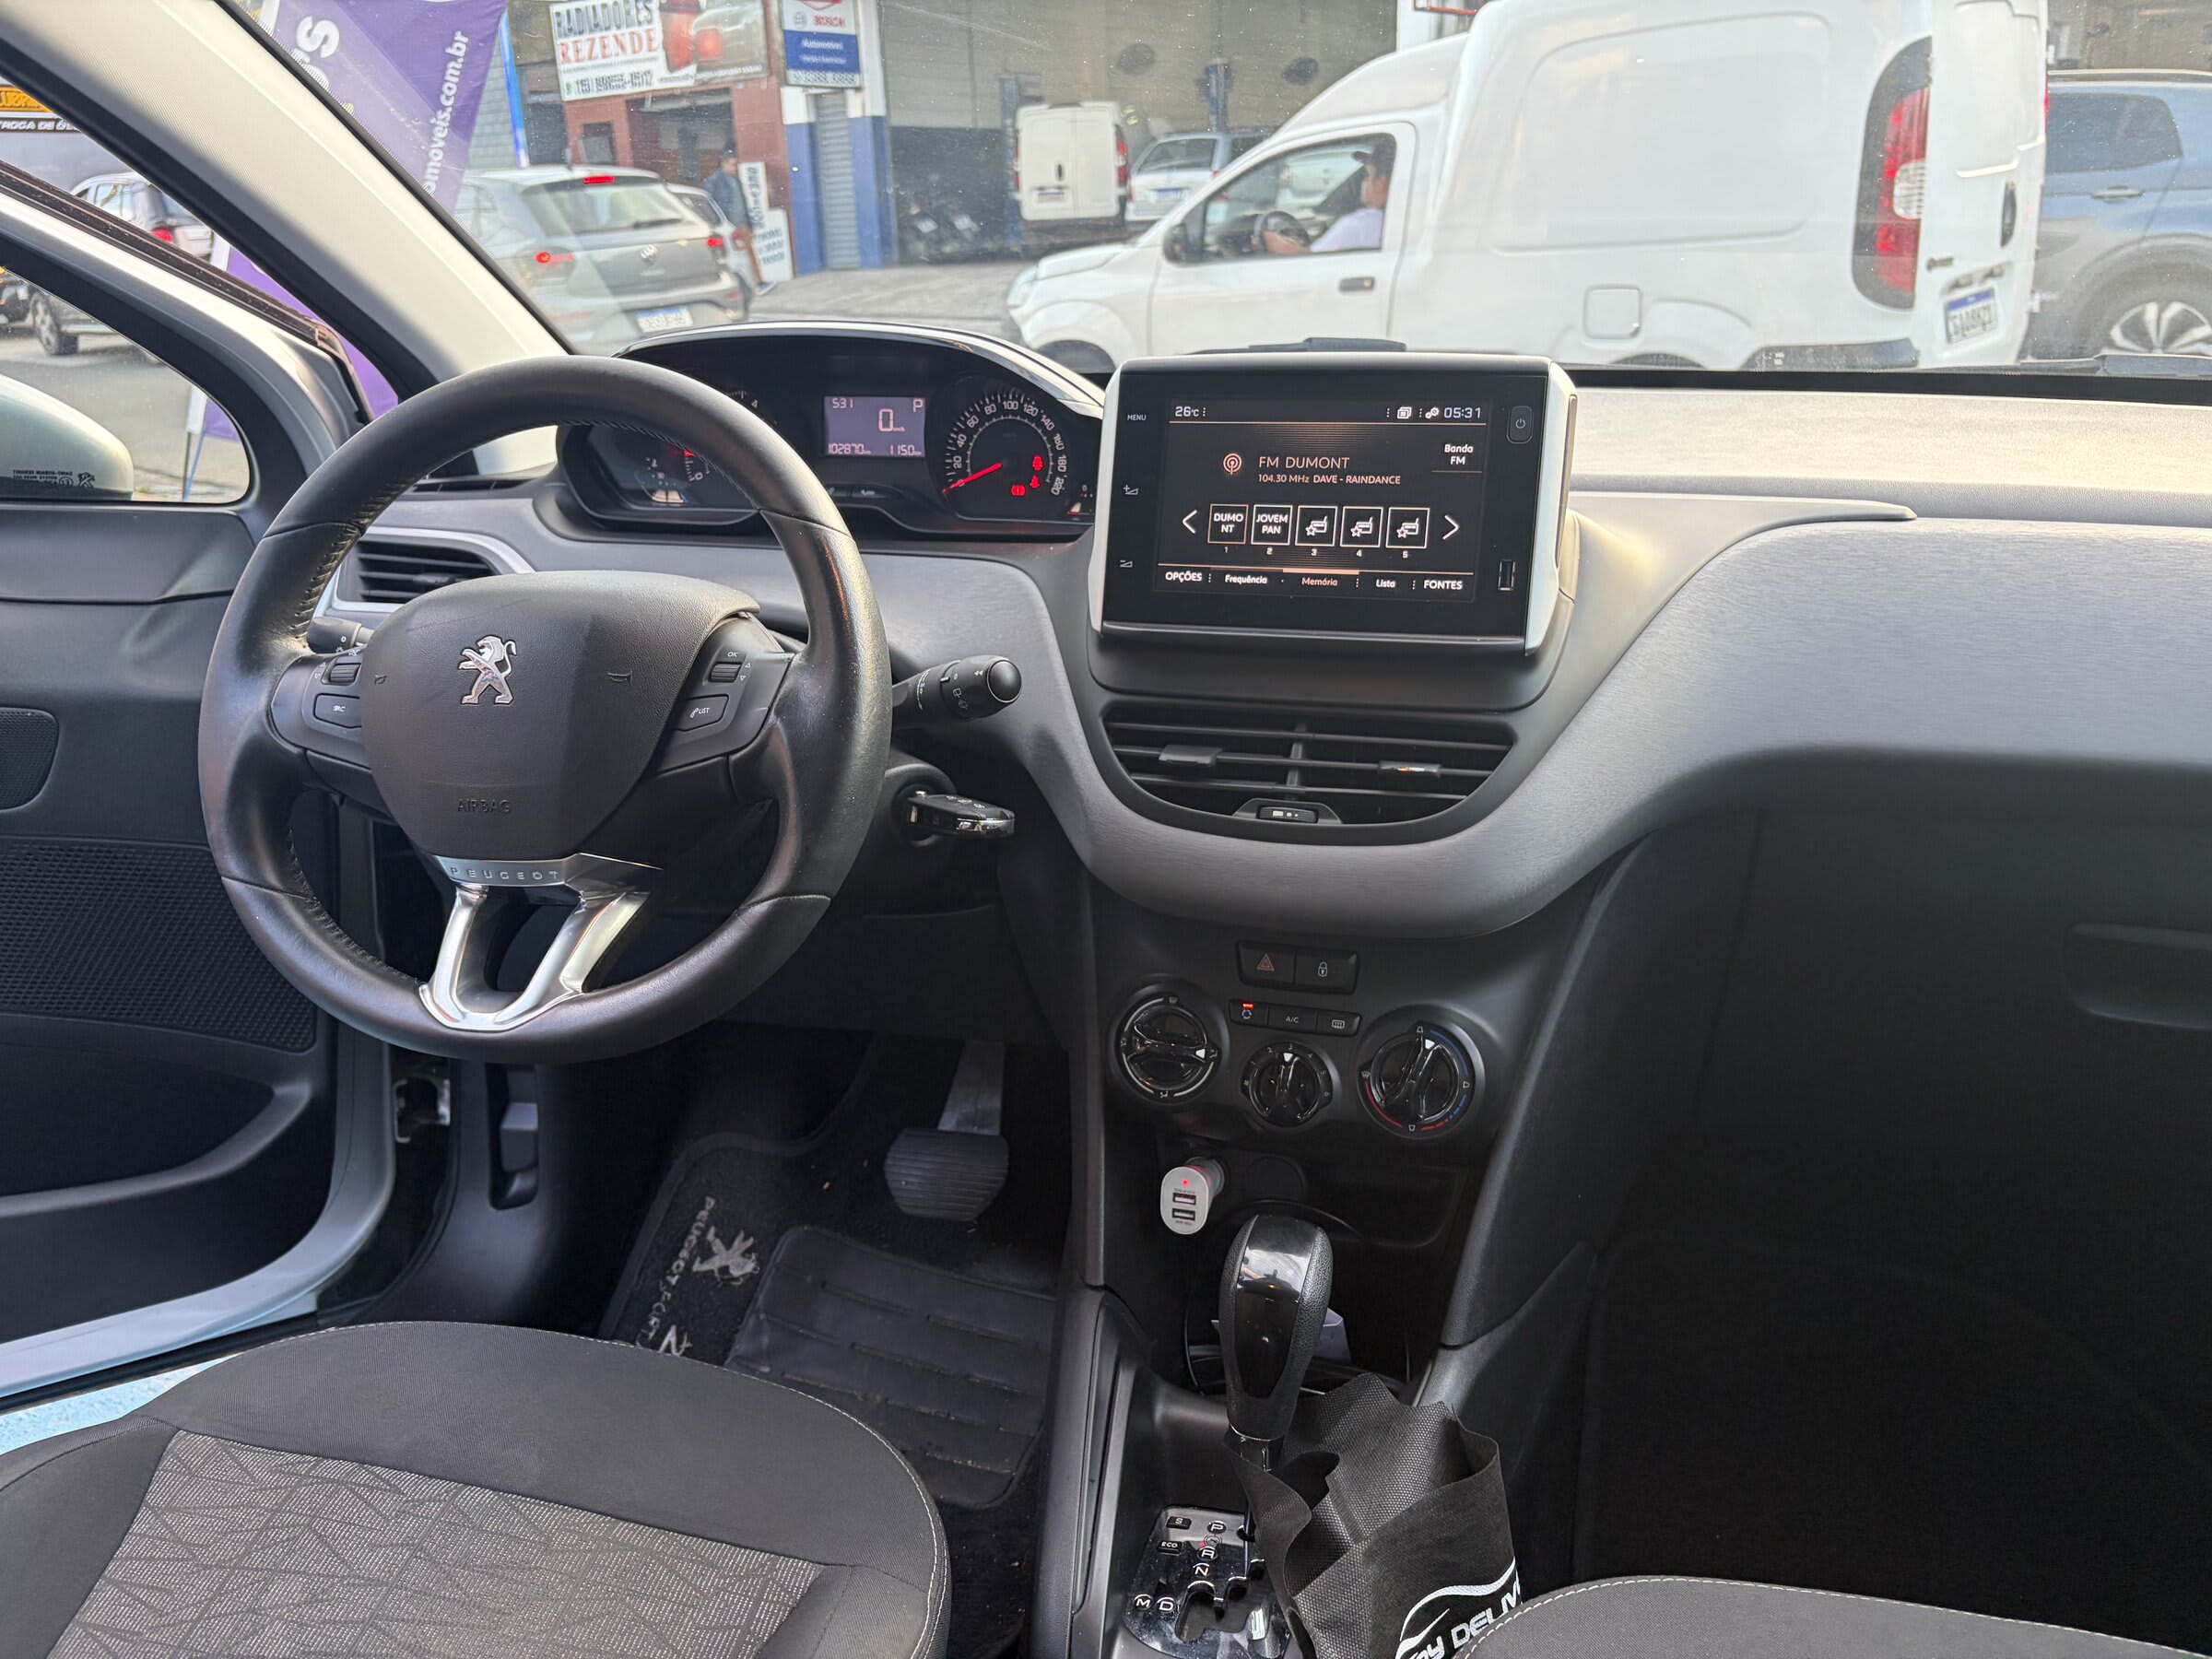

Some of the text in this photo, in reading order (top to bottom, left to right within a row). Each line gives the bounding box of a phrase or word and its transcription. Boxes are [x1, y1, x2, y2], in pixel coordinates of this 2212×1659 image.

[559, 29, 658, 65] REZENDE
[913, 398, 924, 413] P
[984, 404, 997, 415] 80
[1003, 401, 1018, 410] 100
[1023, 403, 1039, 417] 120
[1443, 406, 1481, 418] 05:31
[878, 408, 894, 432] 0
[967, 416, 980, 428] 60
[1041, 414, 1054, 430] 140
[956, 433, 967, 448] 40
[1053, 433, 1065, 450] 160
[829, 443, 865, 454] 102870
[1444, 444, 1473, 453] Banda
[953, 455, 962, 468] 20
[1057, 454, 1066, 472] 180
[1259, 456, 1349, 469] FM DUMONT
[1450, 455, 1465, 465] FM
[1258, 474, 1287, 483] 104.30
[1288, 475, 1309, 483] MHz
[1313, 475, 1337, 484] DAVE
[1346, 476, 1401, 485] RAINDANCE
[1214, 513, 1243, 523] DUMO
[1255, 513, 1288, 524] JOVEM
[1220, 524, 1235, 533] NT
[1262, 525, 1281, 535] PAN
[1165, 571, 1202, 583] OPÇÕES
[1225, 574, 1267, 585] Frequência
[1301, 577, 1338, 586] Memória
[1376, 579, 1395, 588] Lista
[1424, 580, 1463, 590] FONTES
[457, 798, 510, 813] AIRBAG
[450, 867, 559, 880] PEUGEOT
[1194, 1566, 1208, 1576] N
[1135, 1598, 1151, 1607] M
[1159, 1601, 1173, 1611] D
